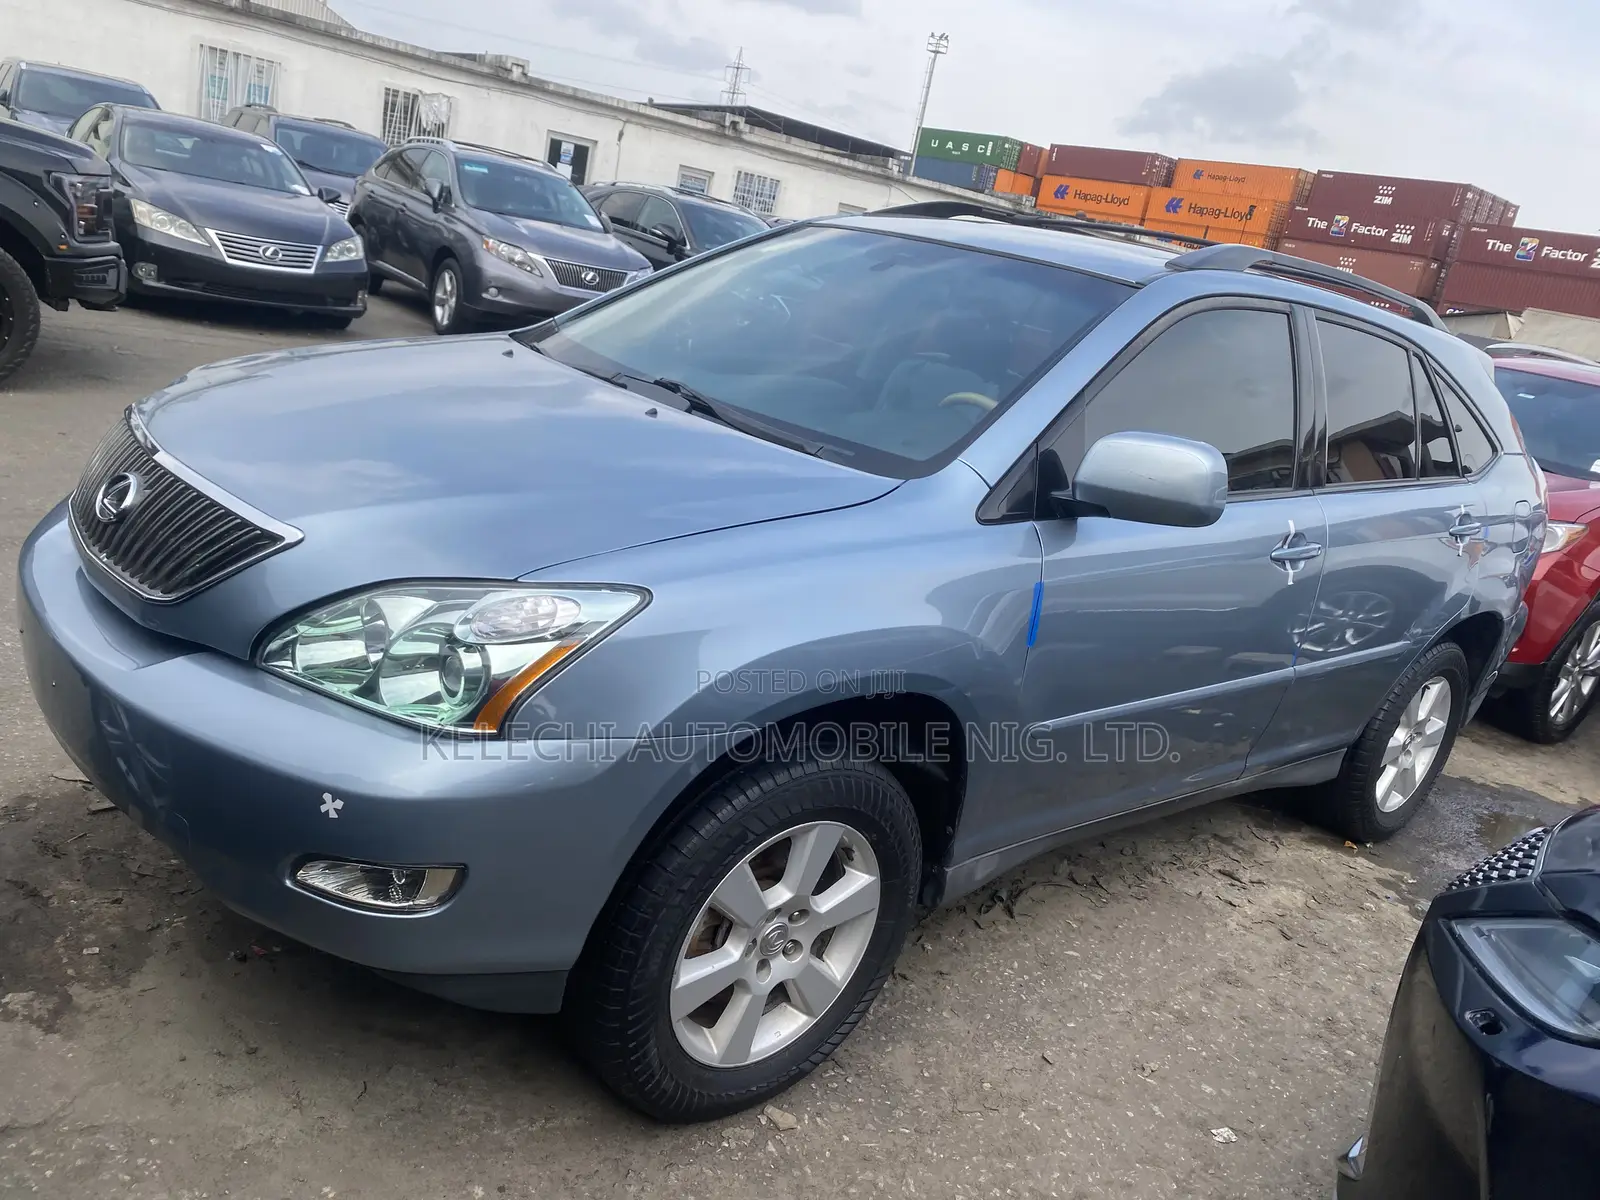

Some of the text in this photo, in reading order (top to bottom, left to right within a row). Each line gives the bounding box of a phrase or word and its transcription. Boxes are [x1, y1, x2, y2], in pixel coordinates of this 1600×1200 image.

[1207, 172, 1246, 183] Hapag-Lloyd
[1073, 189, 1130, 207] Hapag-Lloyd
[1373, 195, 1393, 205] ZIM
[1187, 202, 1253, 222] Hapag-Lloyd
[1307, 217, 1328, 229] The
[1350, 222, 1388, 237] Factor
[1390, 232, 1413, 245] ZIM
[1486, 239, 1513, 252] The
[1541, 246, 1589, 262] Factor
